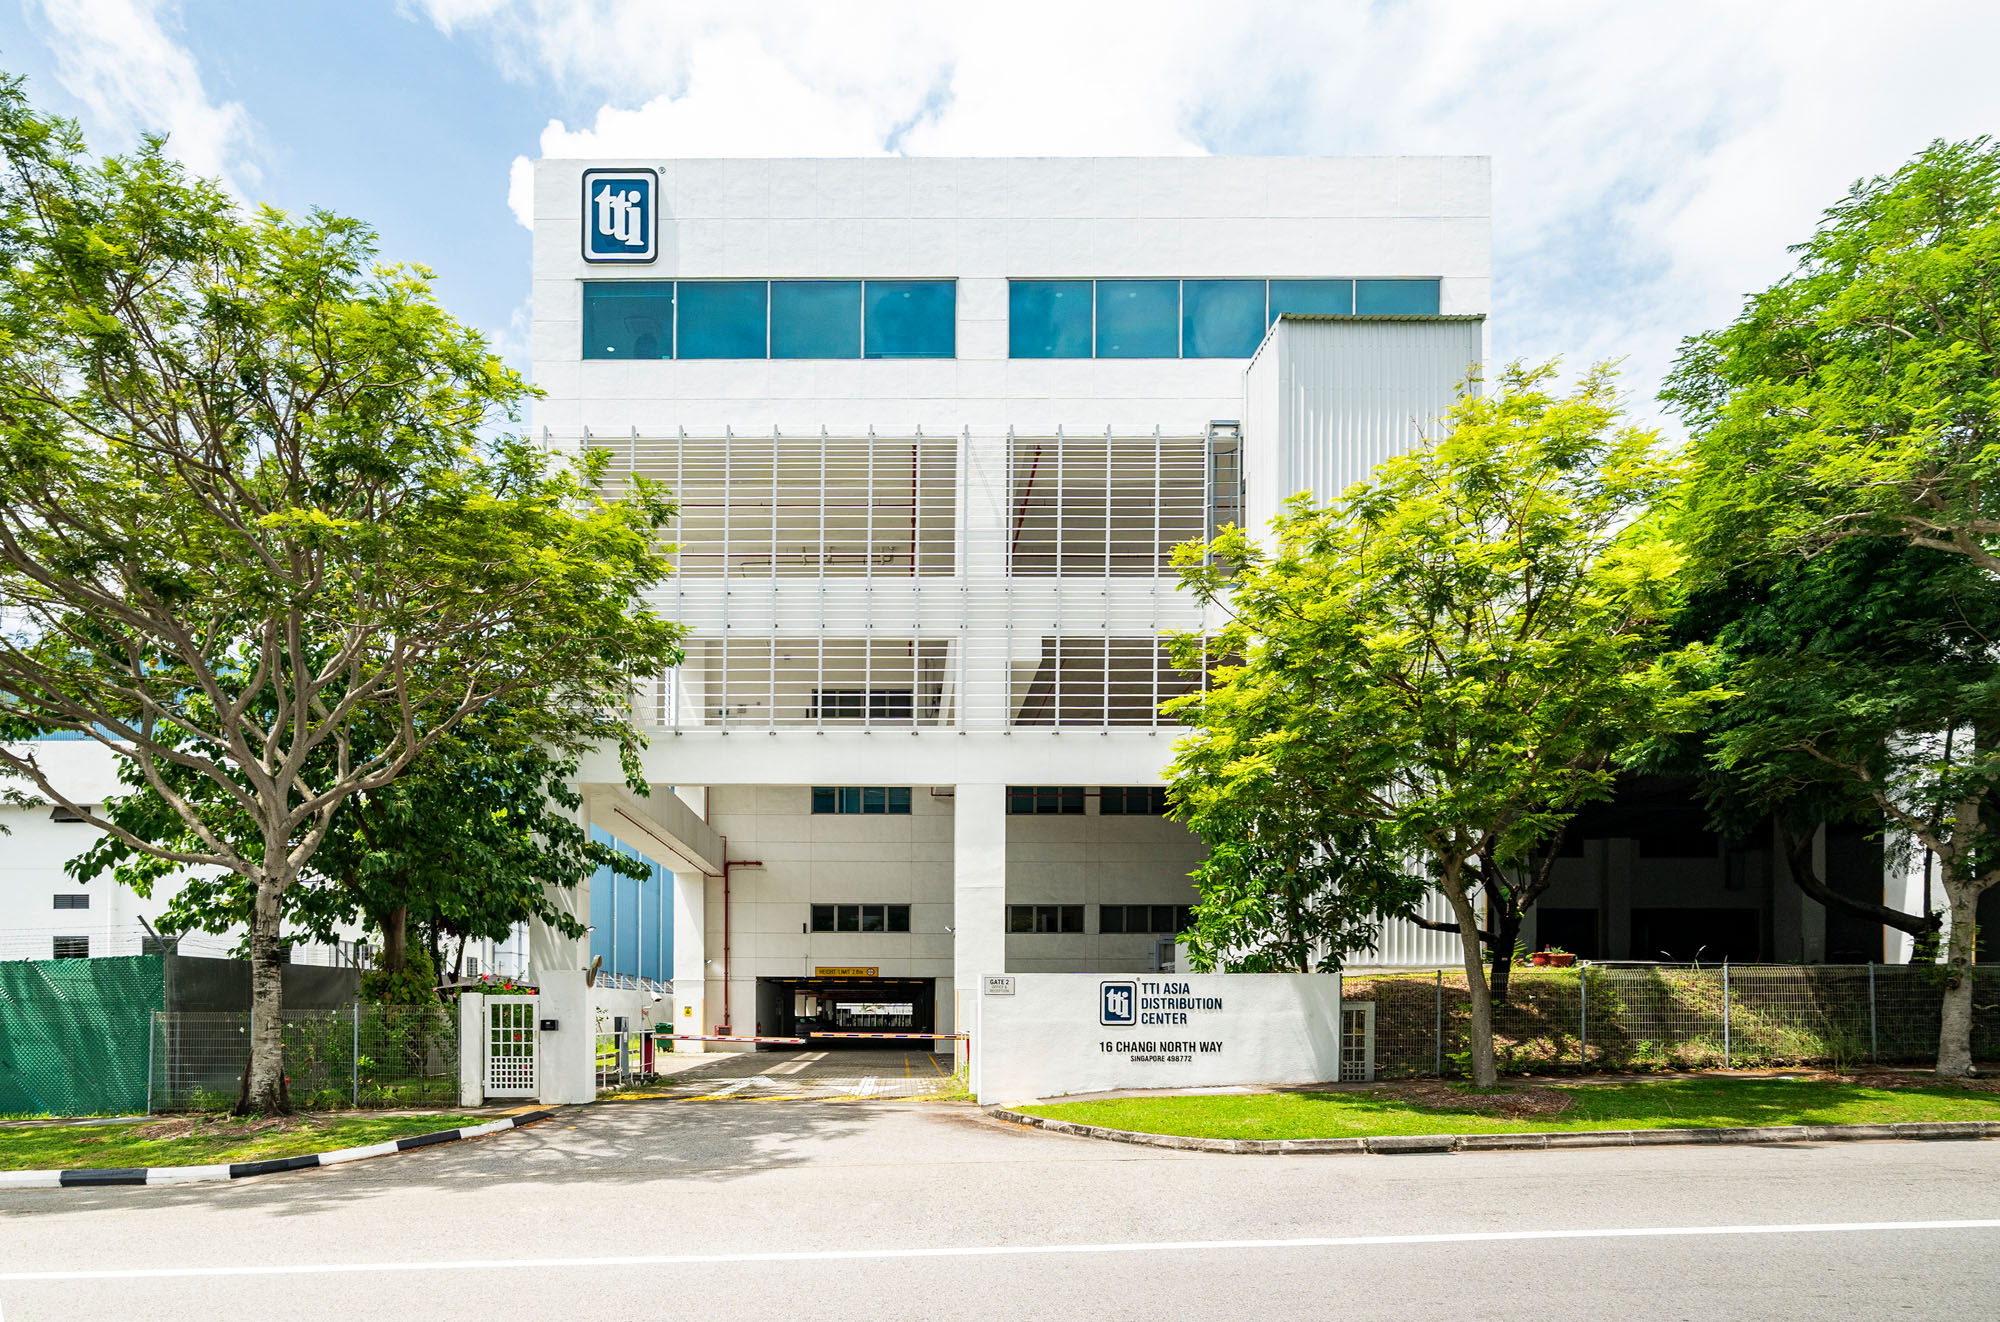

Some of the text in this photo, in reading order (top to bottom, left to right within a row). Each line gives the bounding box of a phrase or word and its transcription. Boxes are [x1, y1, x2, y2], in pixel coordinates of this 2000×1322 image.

[594, 184, 645, 246] tti
[1141, 982, 1190, 995] TTI ASIA
[1106, 988, 1130, 1018] tti
[1141, 997, 1222, 1010] DISTRIBUTION
[1141, 1012, 1187, 1025] CENTER
[1099, 1041, 1223, 1053] 16 CHANGI NORTH WAY
